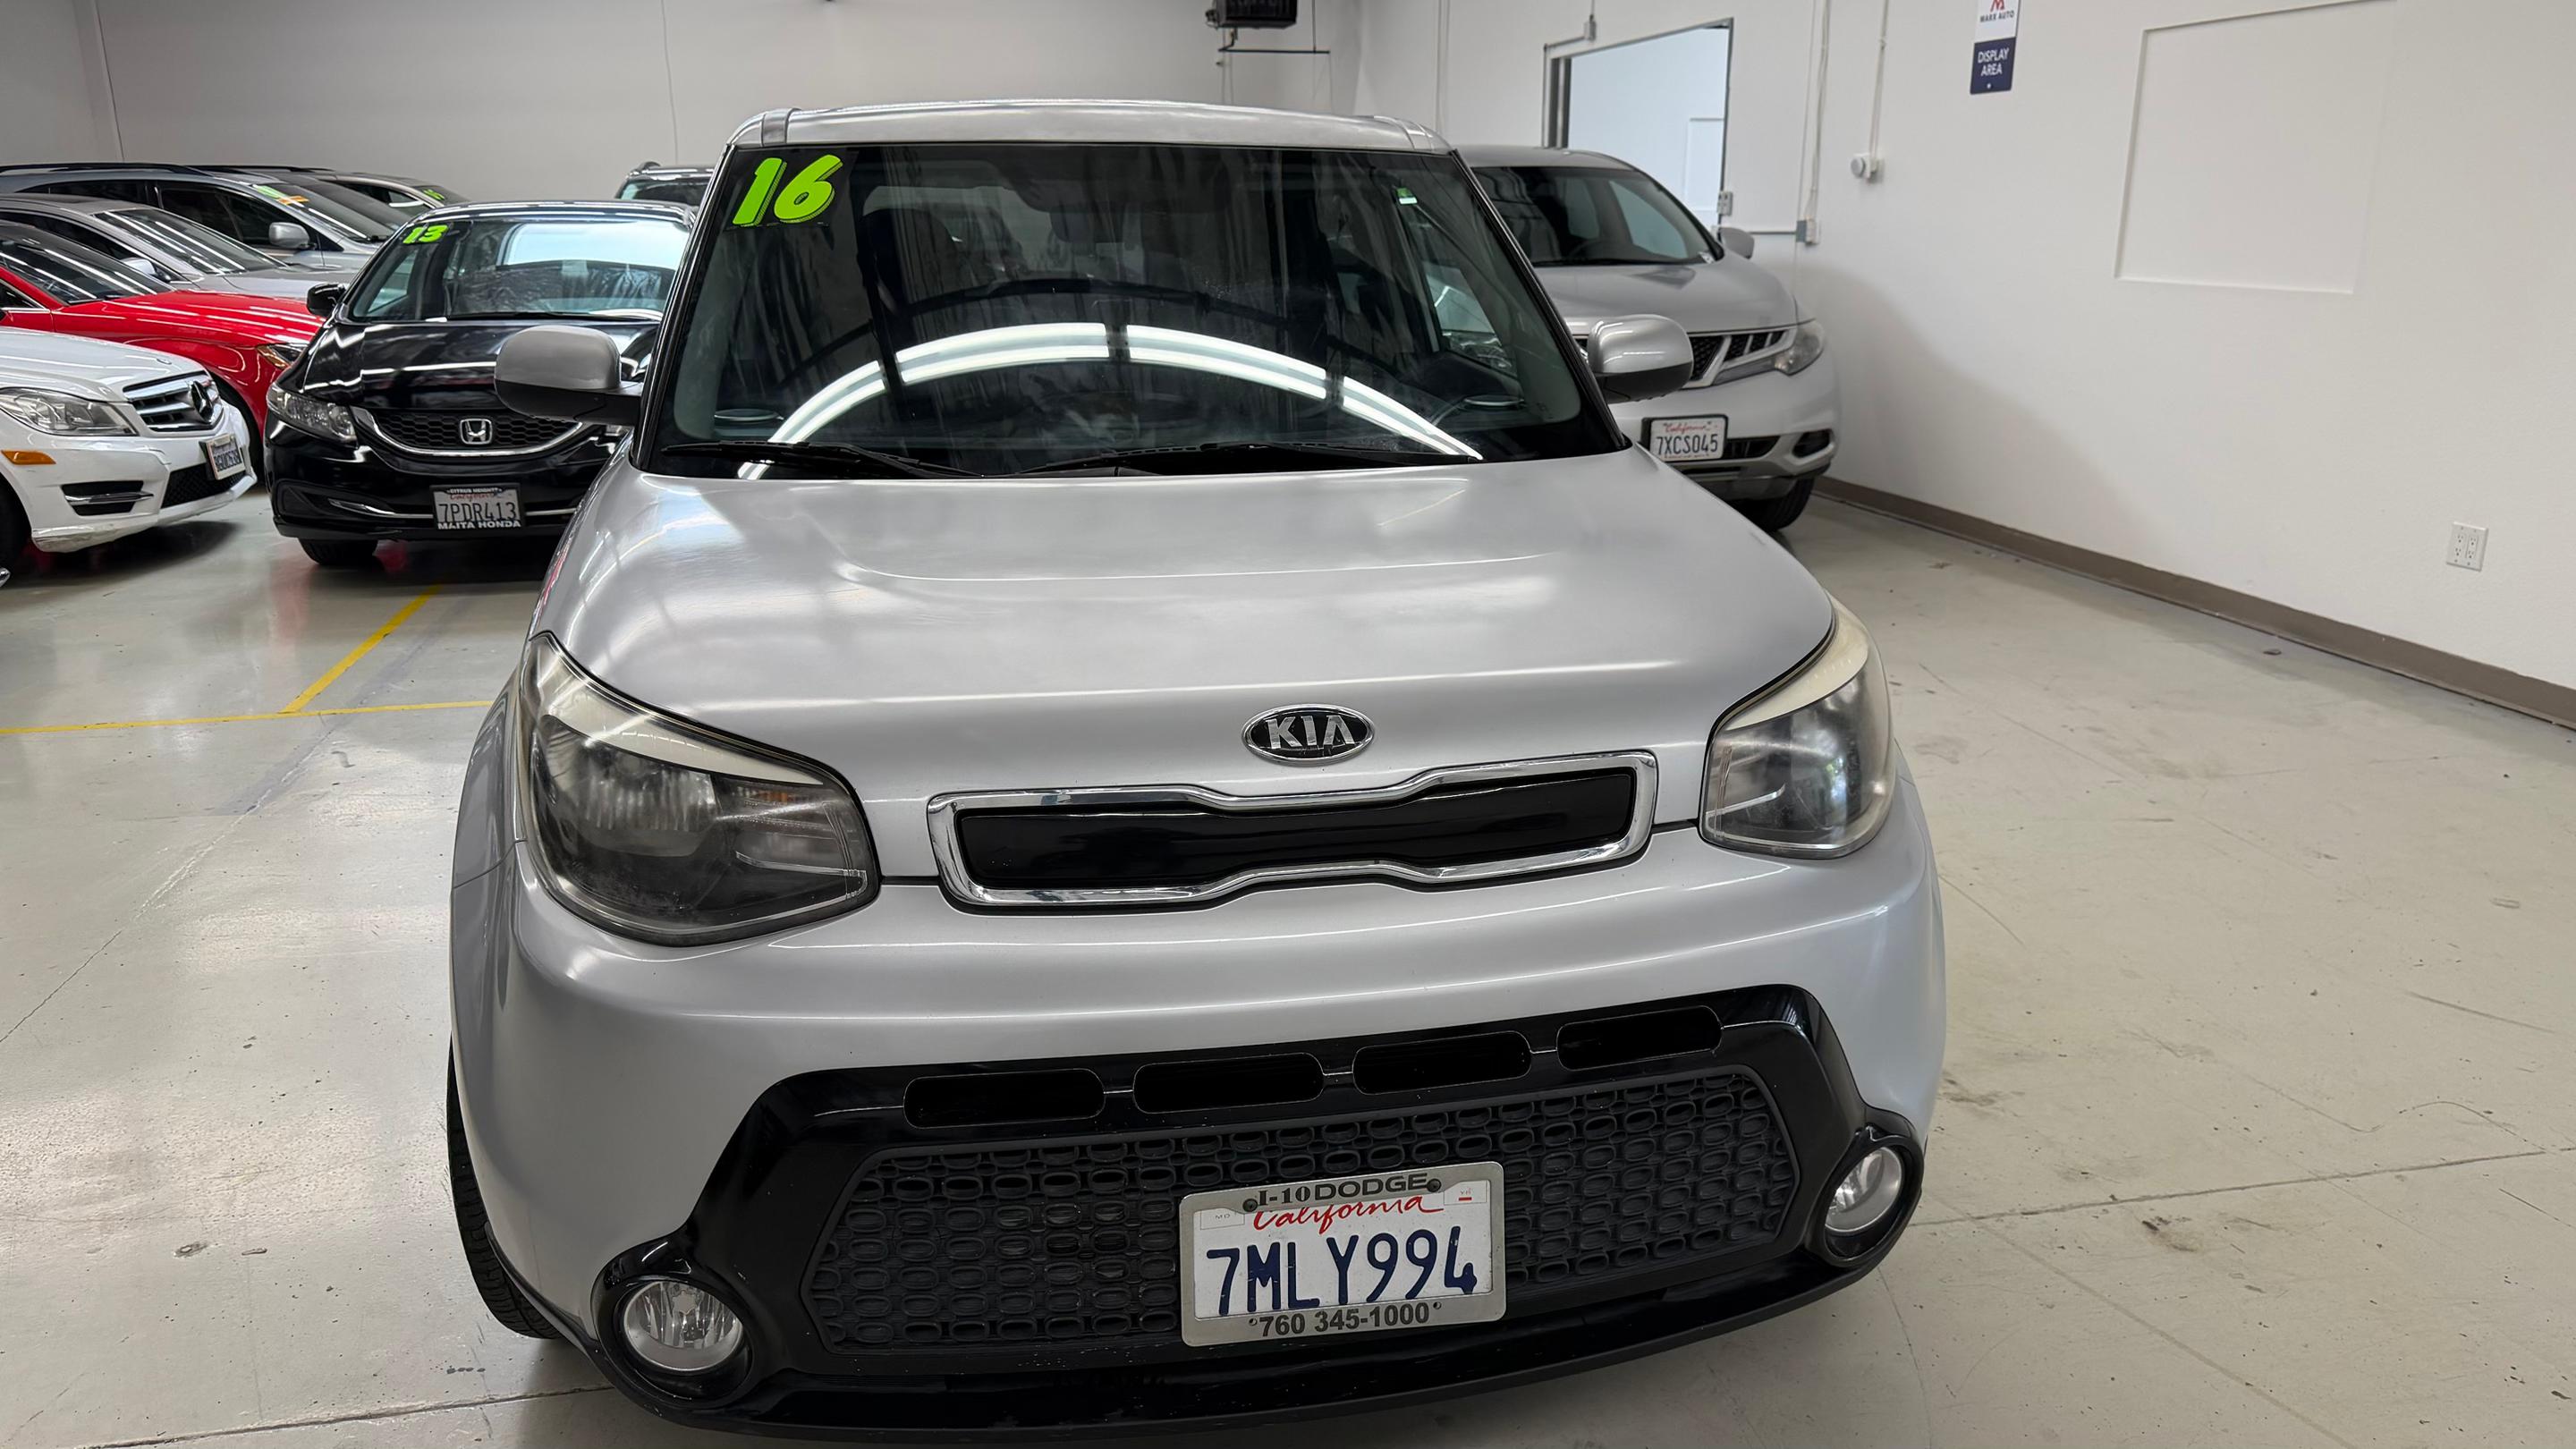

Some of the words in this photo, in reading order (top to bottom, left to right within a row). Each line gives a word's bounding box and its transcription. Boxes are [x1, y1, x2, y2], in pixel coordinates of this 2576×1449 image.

[1978, 47, 2010, 64] DISPLAY
[1980, 63, 2003, 77] AREA
[733, 154, 843, 227] 16
[402, 225, 449, 244] 13
[1656, 434, 1718, 455] 7XCS045
[437, 521, 476, 530] MAITA
[478, 520, 521, 529] HONDA
[438, 502, 517, 522] 7PDR413
[1265, 715, 1355, 750] KIA
[1258, 1186, 1311, 1207] I-10
[1314, 1173, 1428, 1200] DODGE
[1253, 1195, 1445, 1235] California
[1207, 1225, 1478, 1317] 7MLY994
[1259, 1313, 1305, 1338] 760
[1314, 1301, 1429, 1333] 345-1000
